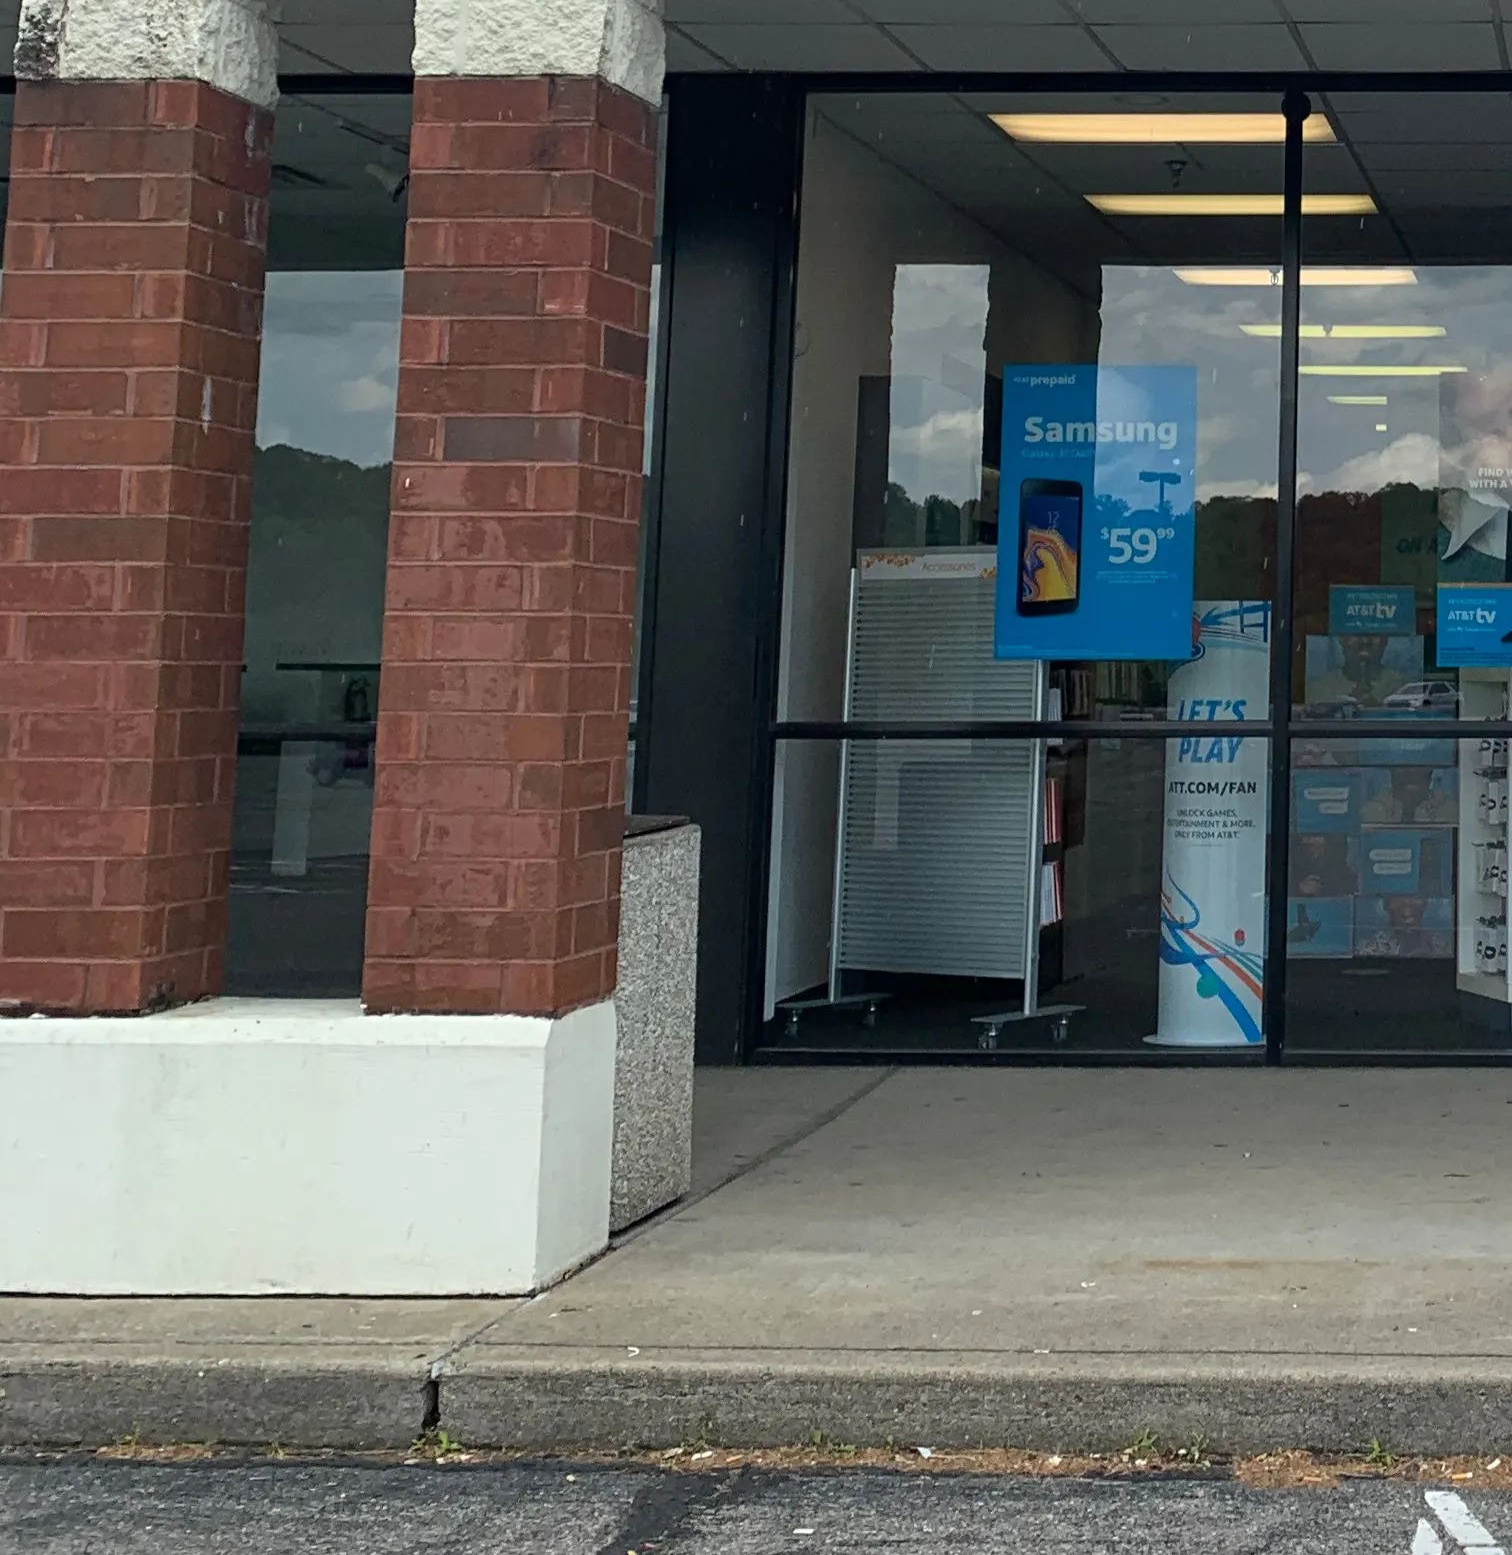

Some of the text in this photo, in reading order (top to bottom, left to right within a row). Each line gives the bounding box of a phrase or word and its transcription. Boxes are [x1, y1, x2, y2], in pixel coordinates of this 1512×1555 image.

[1030, 374, 1076, 388] prepaid
[1024, 416, 1178, 450] Samsung
[1478, 467, 1502, 477] FIND
[1469, 479, 1498, 489] WITH
[1499, 480, 1508, 489] A
[921, 560, 977, 573] Accessories
[1346, 602, 1397, 619] AT&T tv
[1447, 607, 1497, 624] AT&T tv
[1178, 737, 1244, 763] PLAY
[1168, 781, 1257, 796] ATT.COM/FAN
[1192, 831, 1215, 840] FROM
